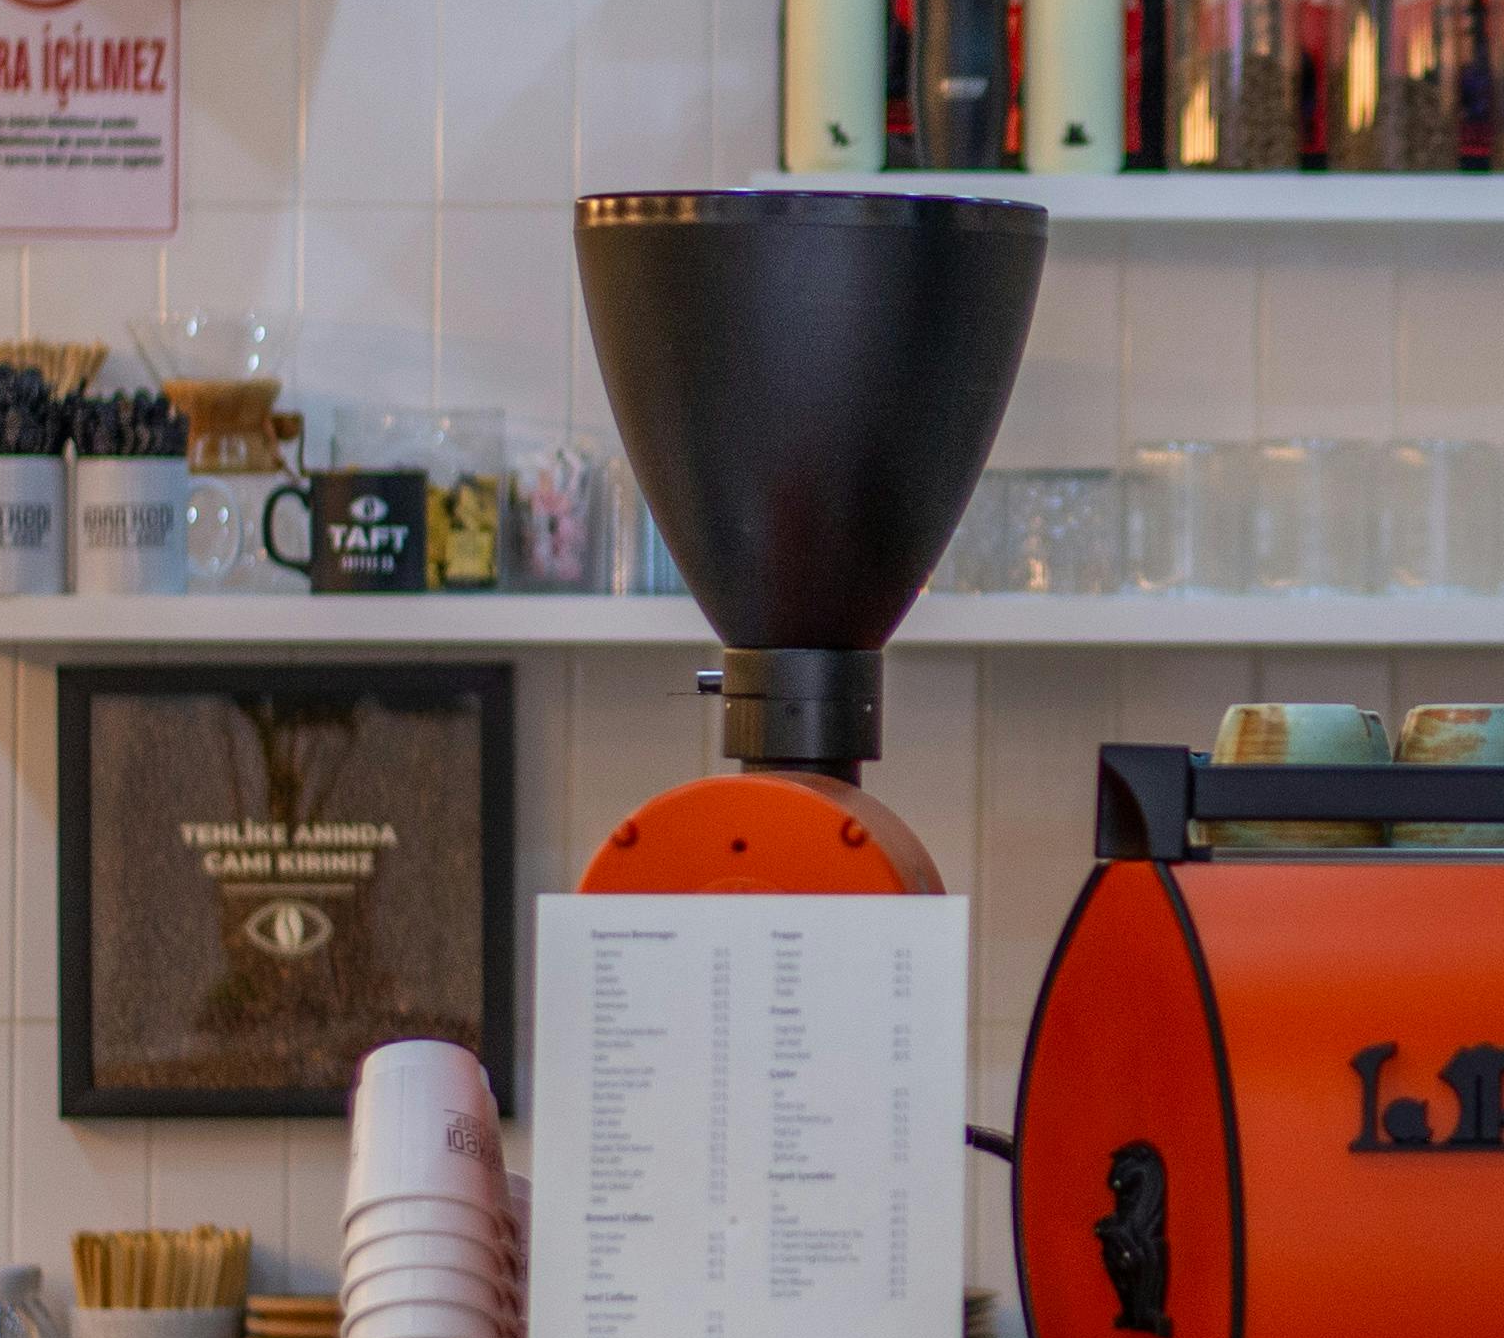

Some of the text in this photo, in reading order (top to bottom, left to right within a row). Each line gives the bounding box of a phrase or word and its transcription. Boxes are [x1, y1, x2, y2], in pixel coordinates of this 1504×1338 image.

[41, 21, 167, 110] İÇİLMEZ
[327, 524, 409, 553] TAFT
[293, 821, 397, 847] ANINDA
